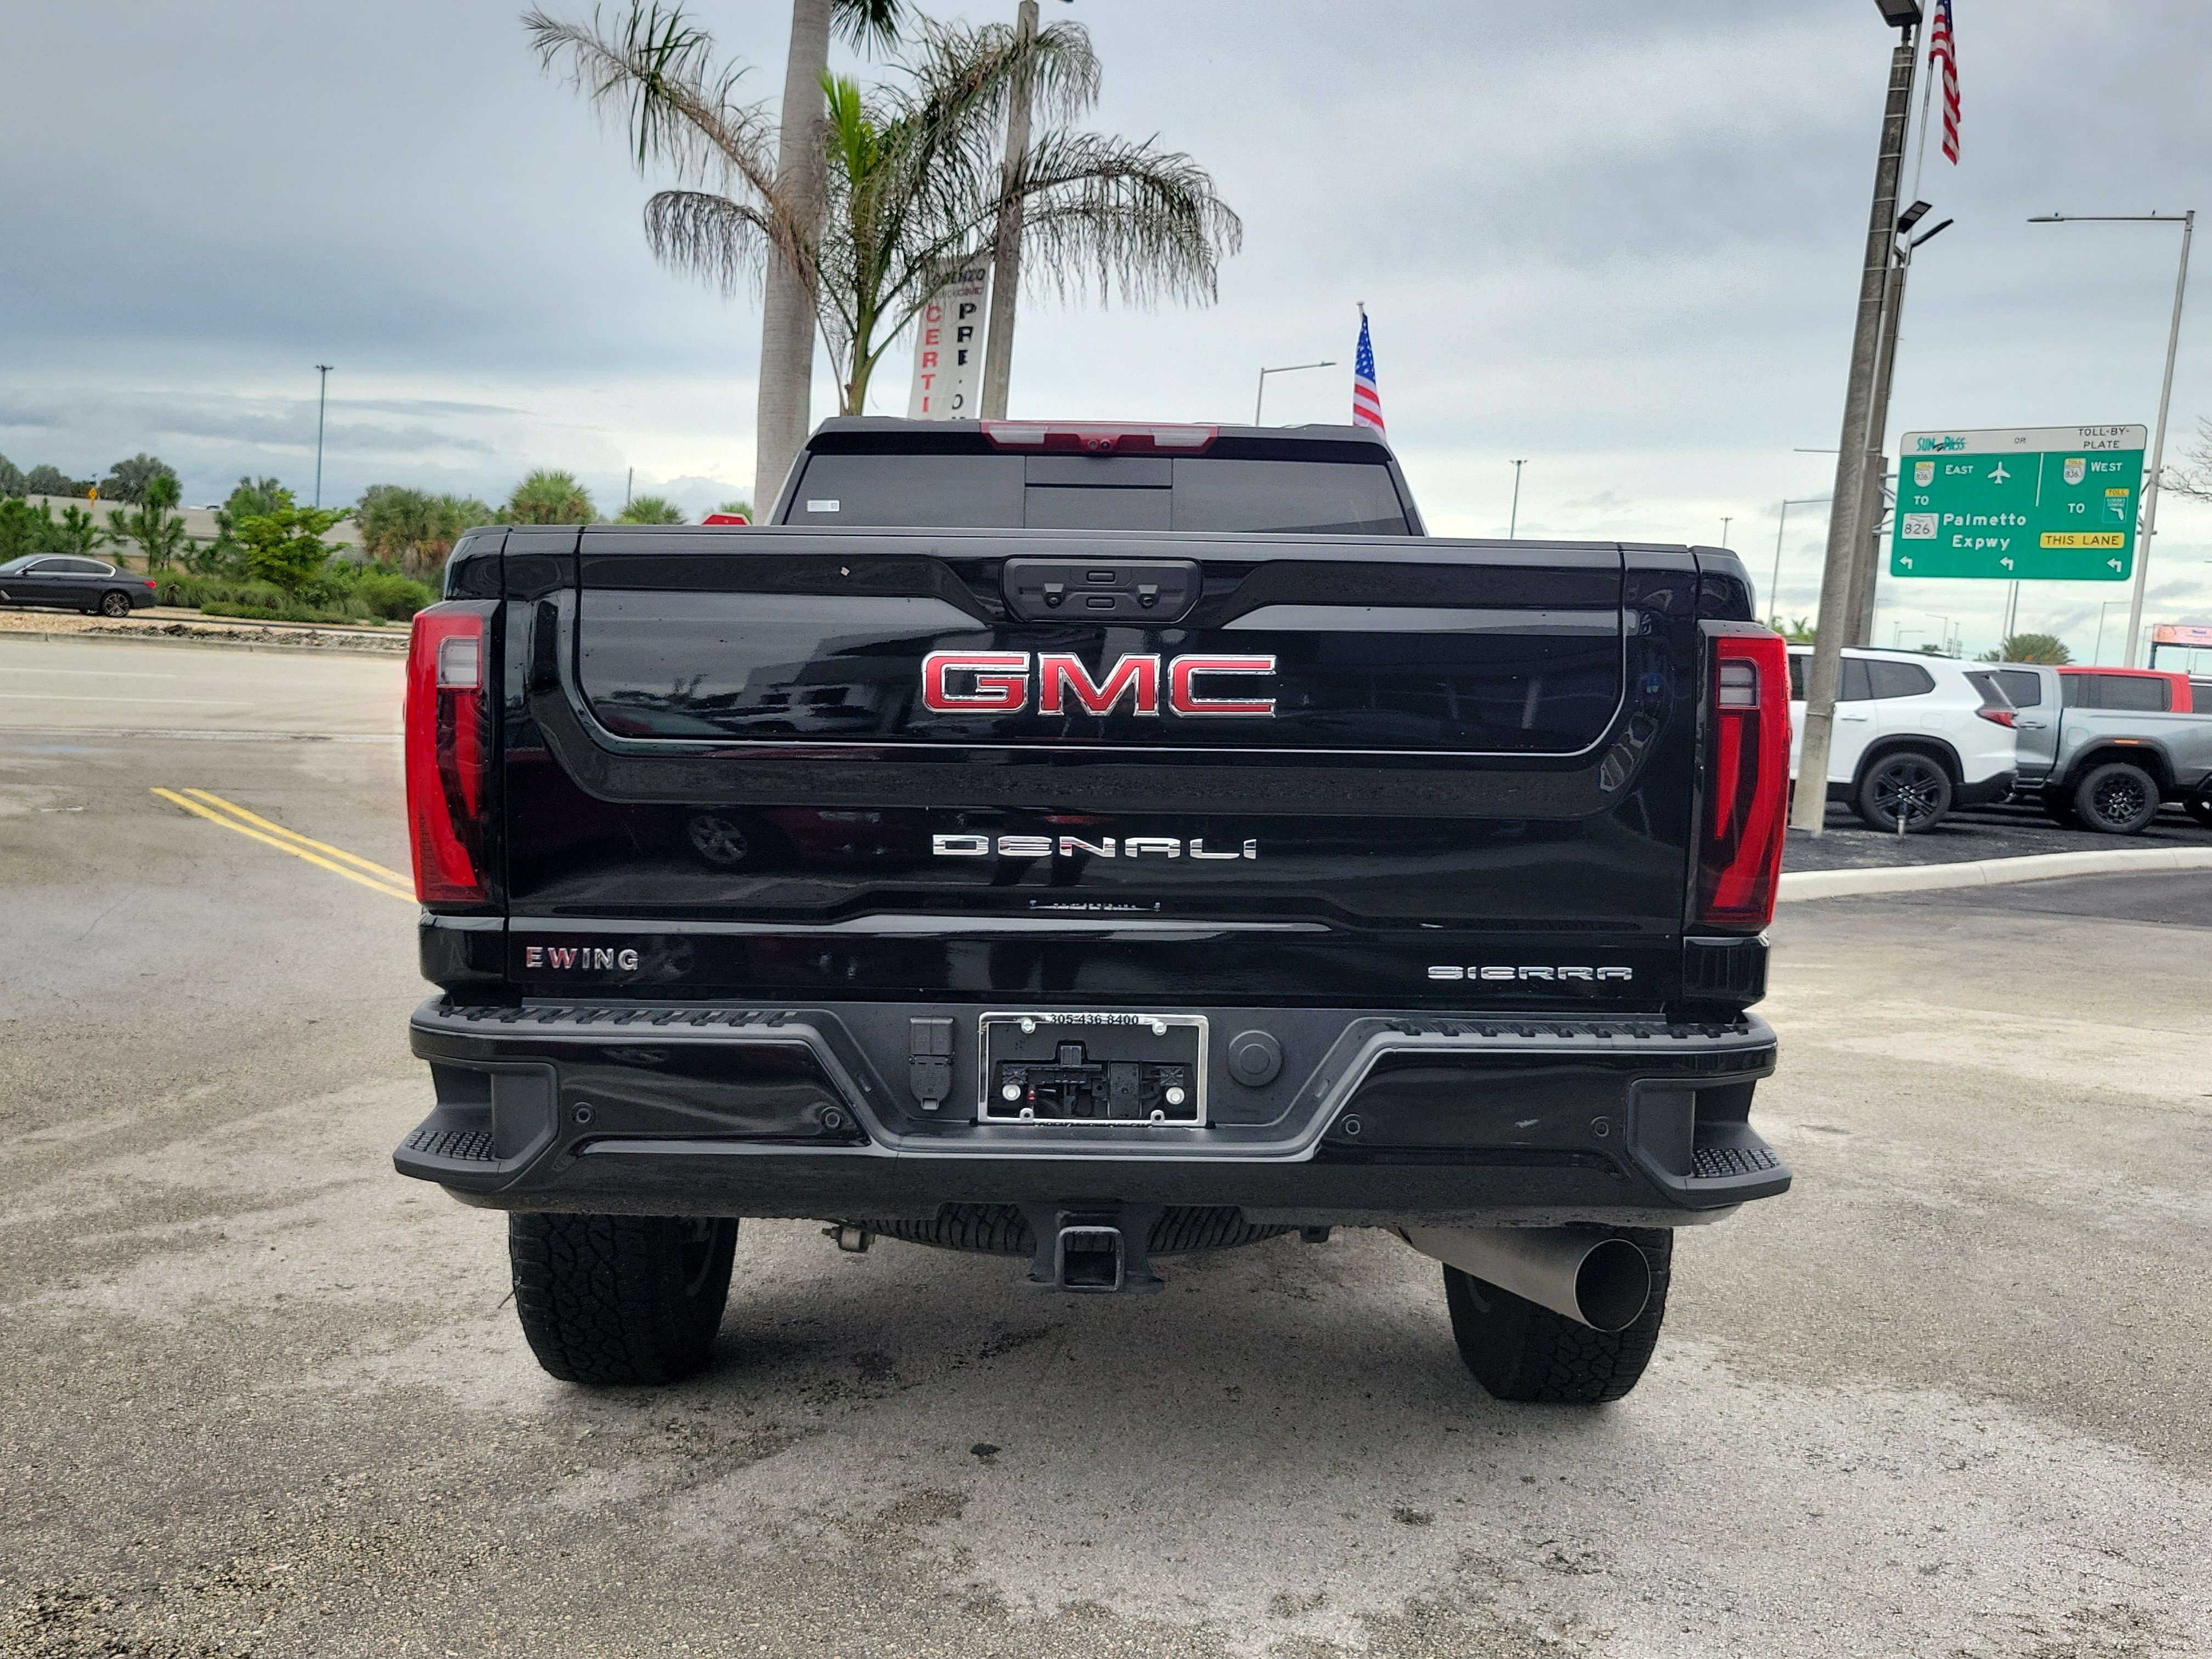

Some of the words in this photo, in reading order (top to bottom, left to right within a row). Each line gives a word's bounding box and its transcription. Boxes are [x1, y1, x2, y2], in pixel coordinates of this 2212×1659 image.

[921, 306, 941, 420] CERTI
[2084, 441, 2120, 449] PLATE
[1945, 465, 1974, 475] EAST
[2090, 461, 2123, 472] WEST
[1914, 495, 1929, 506] TO
[2067, 503, 2085, 514] TO
[1943, 512, 2027, 526] Palmetto
[1904, 523, 1930, 535] 826
[1952, 534, 2011, 551] Expwy
[2045, 535, 2074, 545] THIS
[2082, 535, 2119, 545] LANE
[921, 650, 1277, 719] GMC
[933, 834, 1257, 860] DENALI
[526, 946, 639, 970] EWING
[1427, 966, 1633, 980] SIERRA
